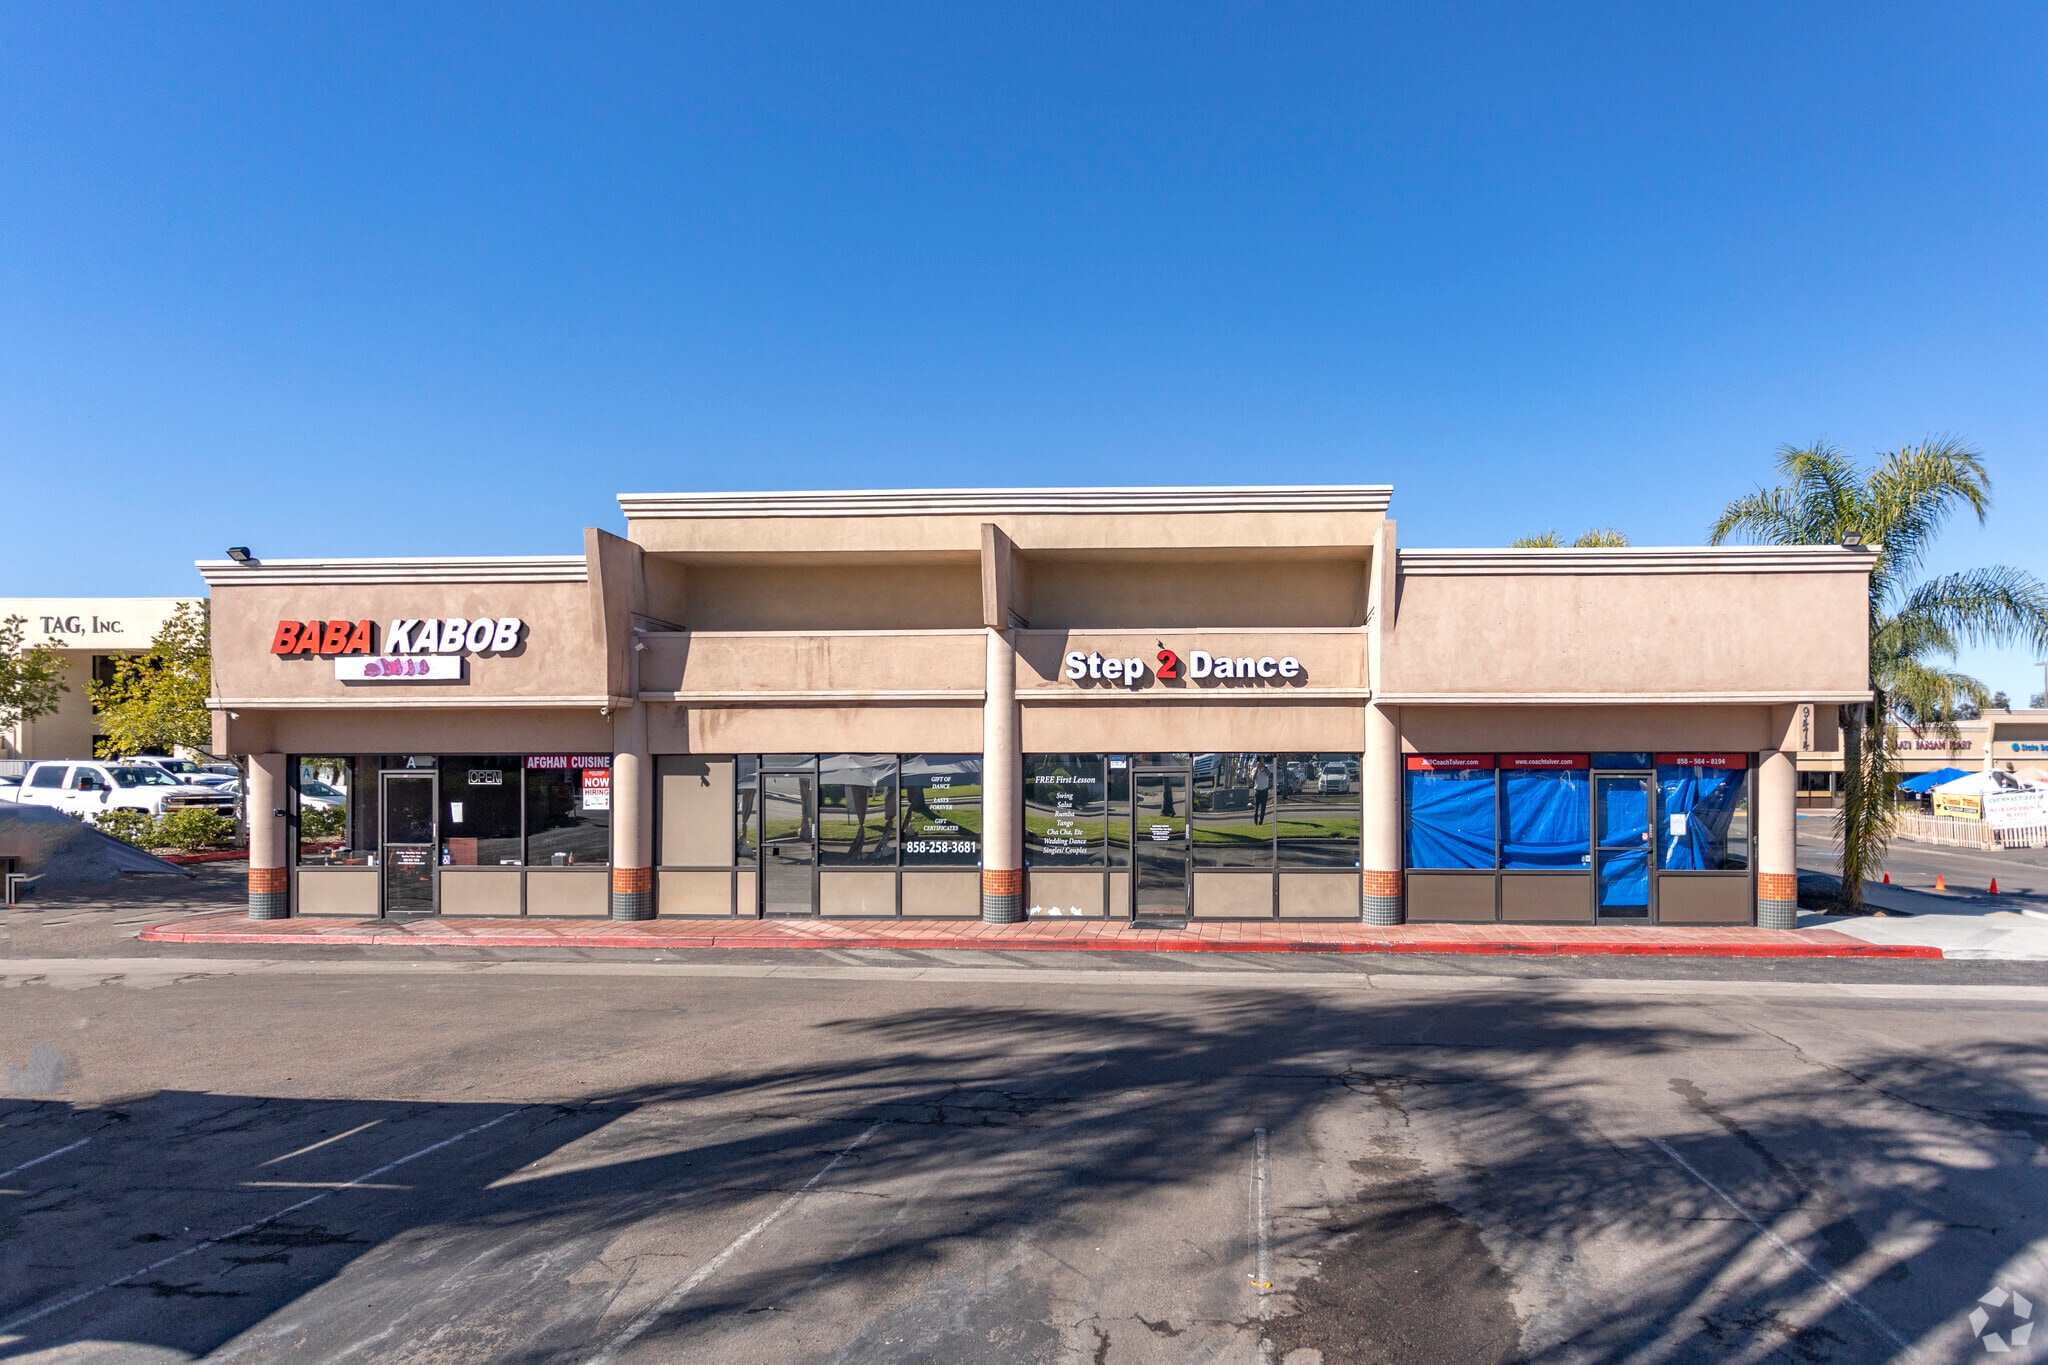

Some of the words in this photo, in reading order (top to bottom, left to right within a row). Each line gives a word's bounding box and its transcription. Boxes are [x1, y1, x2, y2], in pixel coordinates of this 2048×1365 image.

[40, 616, 86, 636] TAG,
[271, 620, 371, 654] BABA
[384, 617, 521, 653] KABOB
[1065, 651, 1144, 686] Step
[1156, 649, 1177, 679] 2
[1189, 650, 1300, 678] Dance
[406, 756, 417, 769] A
[527, 756, 567, 769] AFGHAN
[571, 755, 610, 768] CUISINE
[1515, 758, 1573, 766] www.coachtolver.com
[470, 771, 500, 783] OPEN
[584, 777, 610, 788] NOW
[1035, 775, 1055, 784] FREE
[1056, 775, 1073, 784] First
[1073, 775, 1096, 784] Lesson
[1056, 792, 1074, 801] Swing
[1056, 819, 1074, 828] Tango
[1046, 828, 1059, 836] Cha
[1044, 837, 1068, 846] Wedding
[906, 841, 976, 854] 858-258-3681
[1065, 847, 1087, 856] Couples
